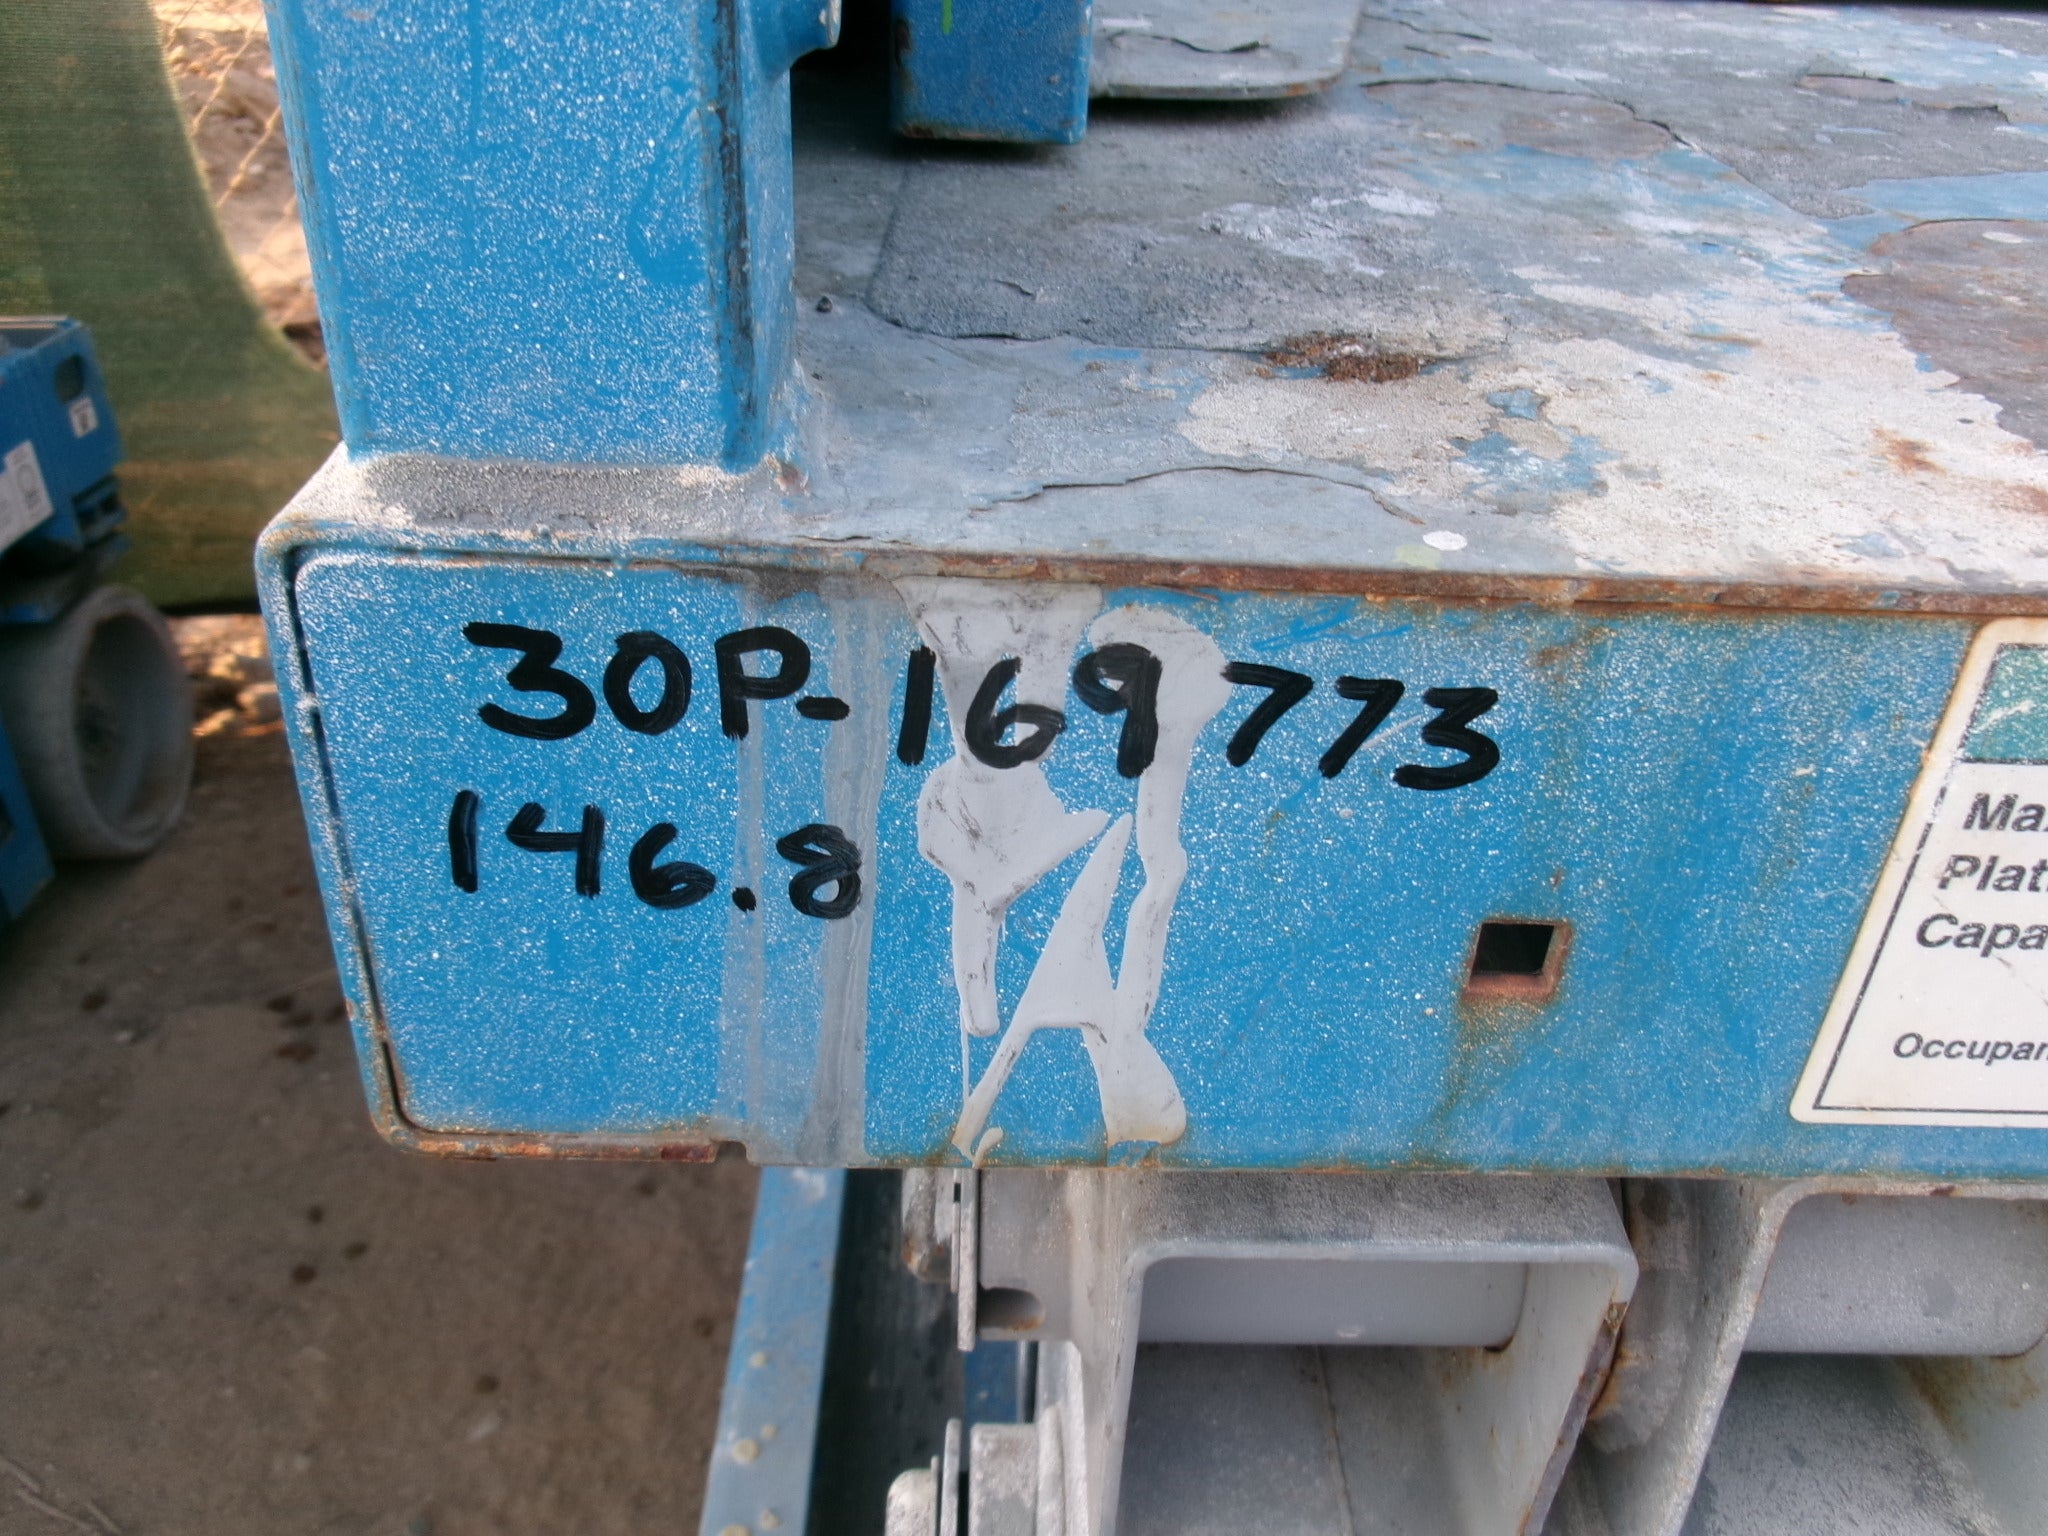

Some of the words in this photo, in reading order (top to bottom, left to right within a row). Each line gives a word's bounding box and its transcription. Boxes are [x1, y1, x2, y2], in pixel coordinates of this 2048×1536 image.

[463, 621, 1500, 792] 30P-169773
[448, 789, 863, 920] 146.8
[1963, 792, 2048, 833] Ma
[1938, 854, 2048, 893] Plat
